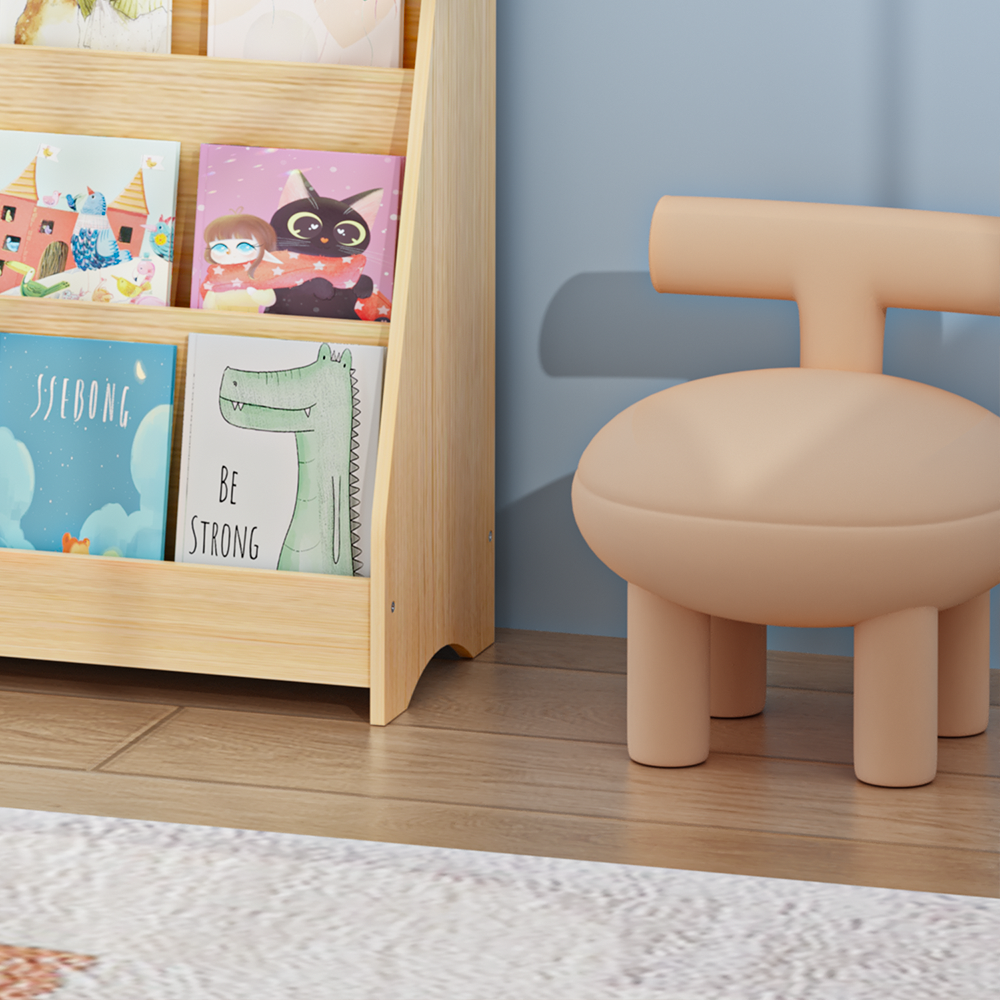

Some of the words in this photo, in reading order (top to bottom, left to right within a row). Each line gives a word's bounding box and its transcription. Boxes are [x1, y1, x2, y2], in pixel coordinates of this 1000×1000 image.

[30, 373, 130, 428] SSEBONG
[219, 465, 239, 505] BE
[189, 515, 260, 561] STRONG
